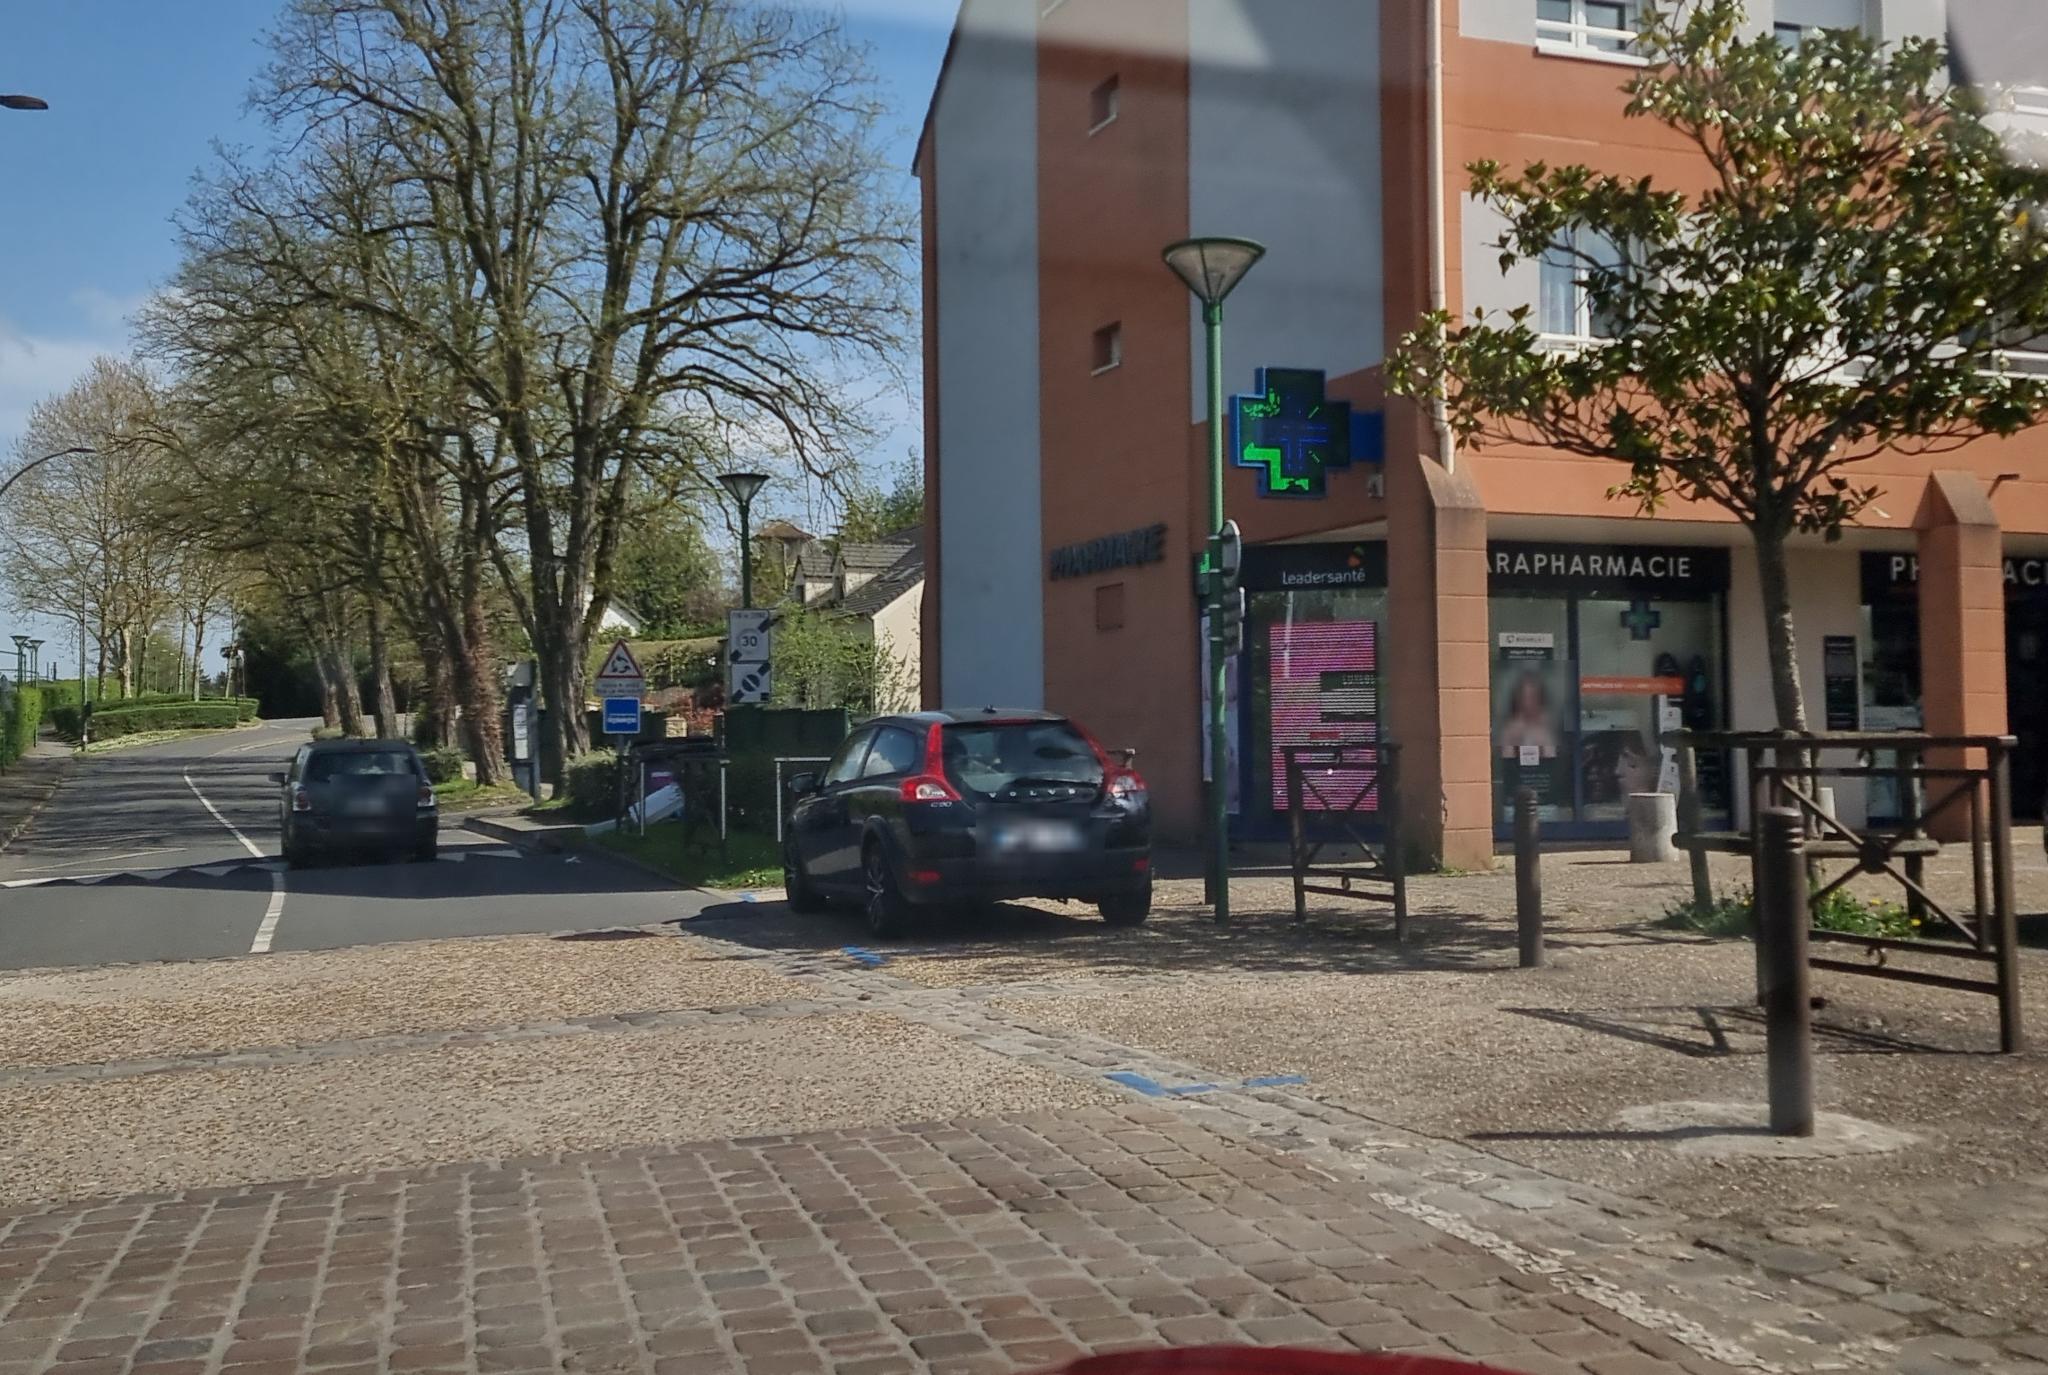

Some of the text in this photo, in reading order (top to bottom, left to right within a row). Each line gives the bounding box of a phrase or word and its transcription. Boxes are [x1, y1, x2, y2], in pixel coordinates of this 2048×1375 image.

[1282, 567, 1366, 585] Leadersanté
[742, 635, 758, 647] 30
[988, 787, 1077, 799] VOLVO
